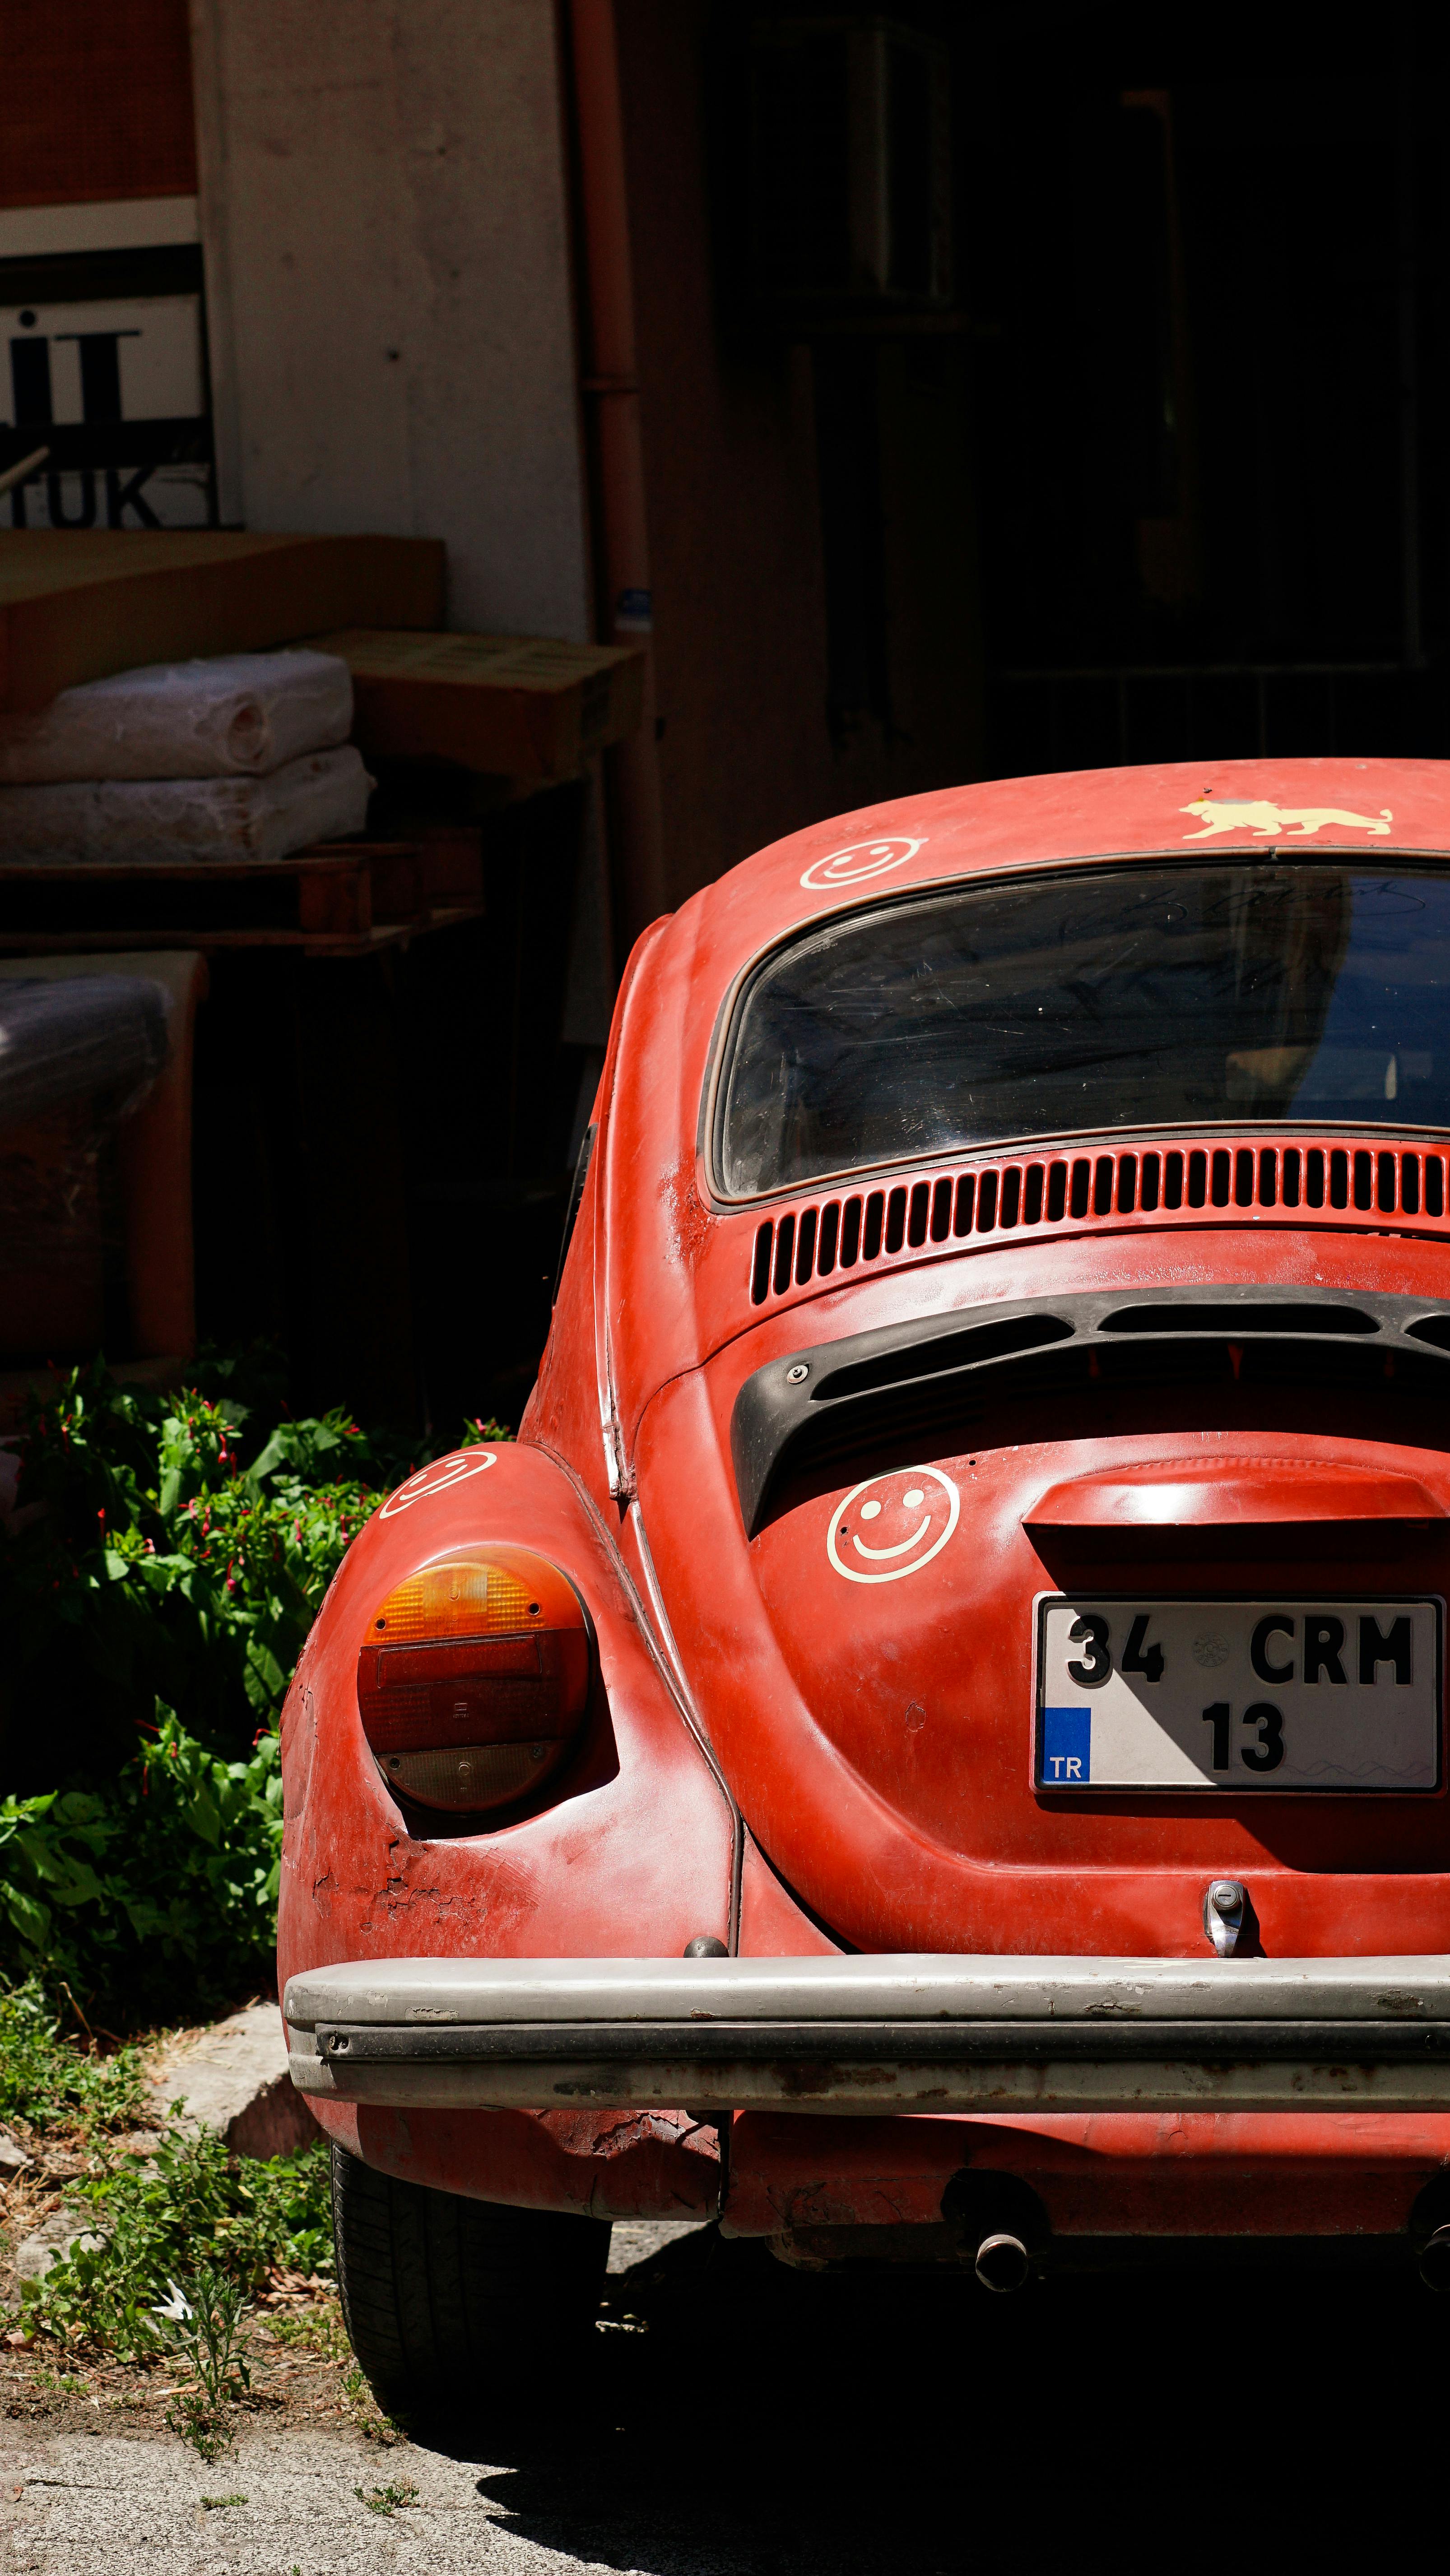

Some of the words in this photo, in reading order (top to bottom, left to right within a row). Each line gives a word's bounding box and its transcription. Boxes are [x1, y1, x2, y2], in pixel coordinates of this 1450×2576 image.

[1065, 1614, 1165, 1686] 34
[1250, 1614, 1412, 1685] CRM
[1050, 1757, 1082, 1778] TR
[1202, 1701, 1285, 1773] 13
